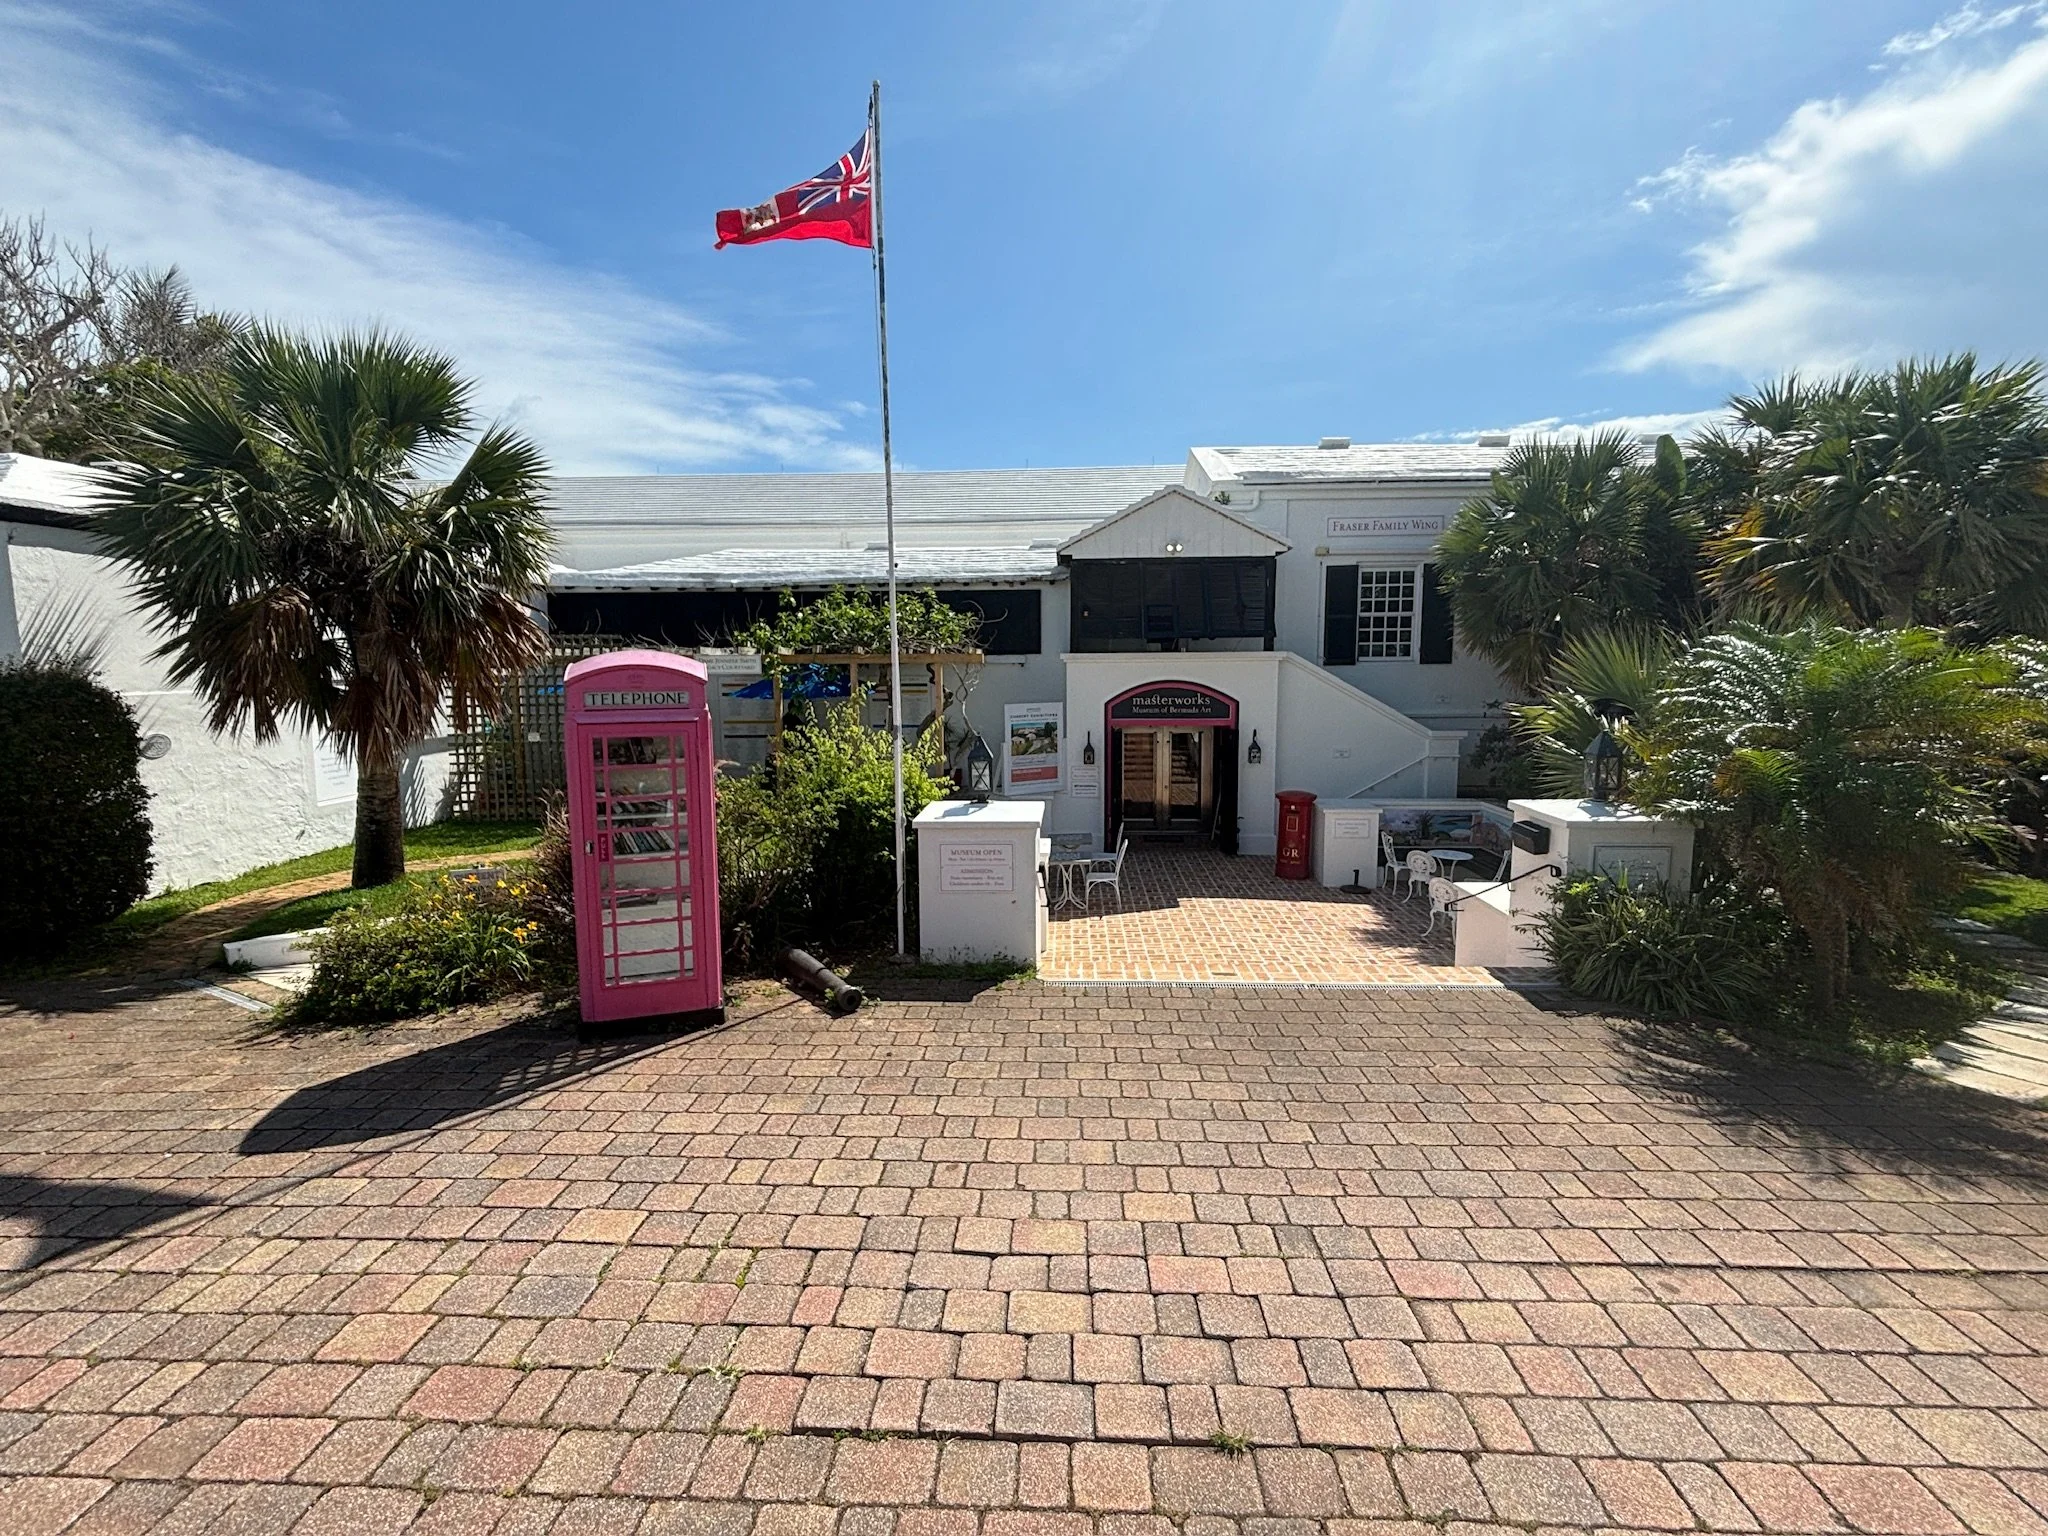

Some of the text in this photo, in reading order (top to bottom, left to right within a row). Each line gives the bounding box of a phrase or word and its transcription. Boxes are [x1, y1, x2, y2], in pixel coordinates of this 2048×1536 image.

[1333, 519, 1439, 532] FRASER FAMILY WING
[588, 693, 687, 705] TELEPHONE
[1132, 693, 1211, 705] masterworks
